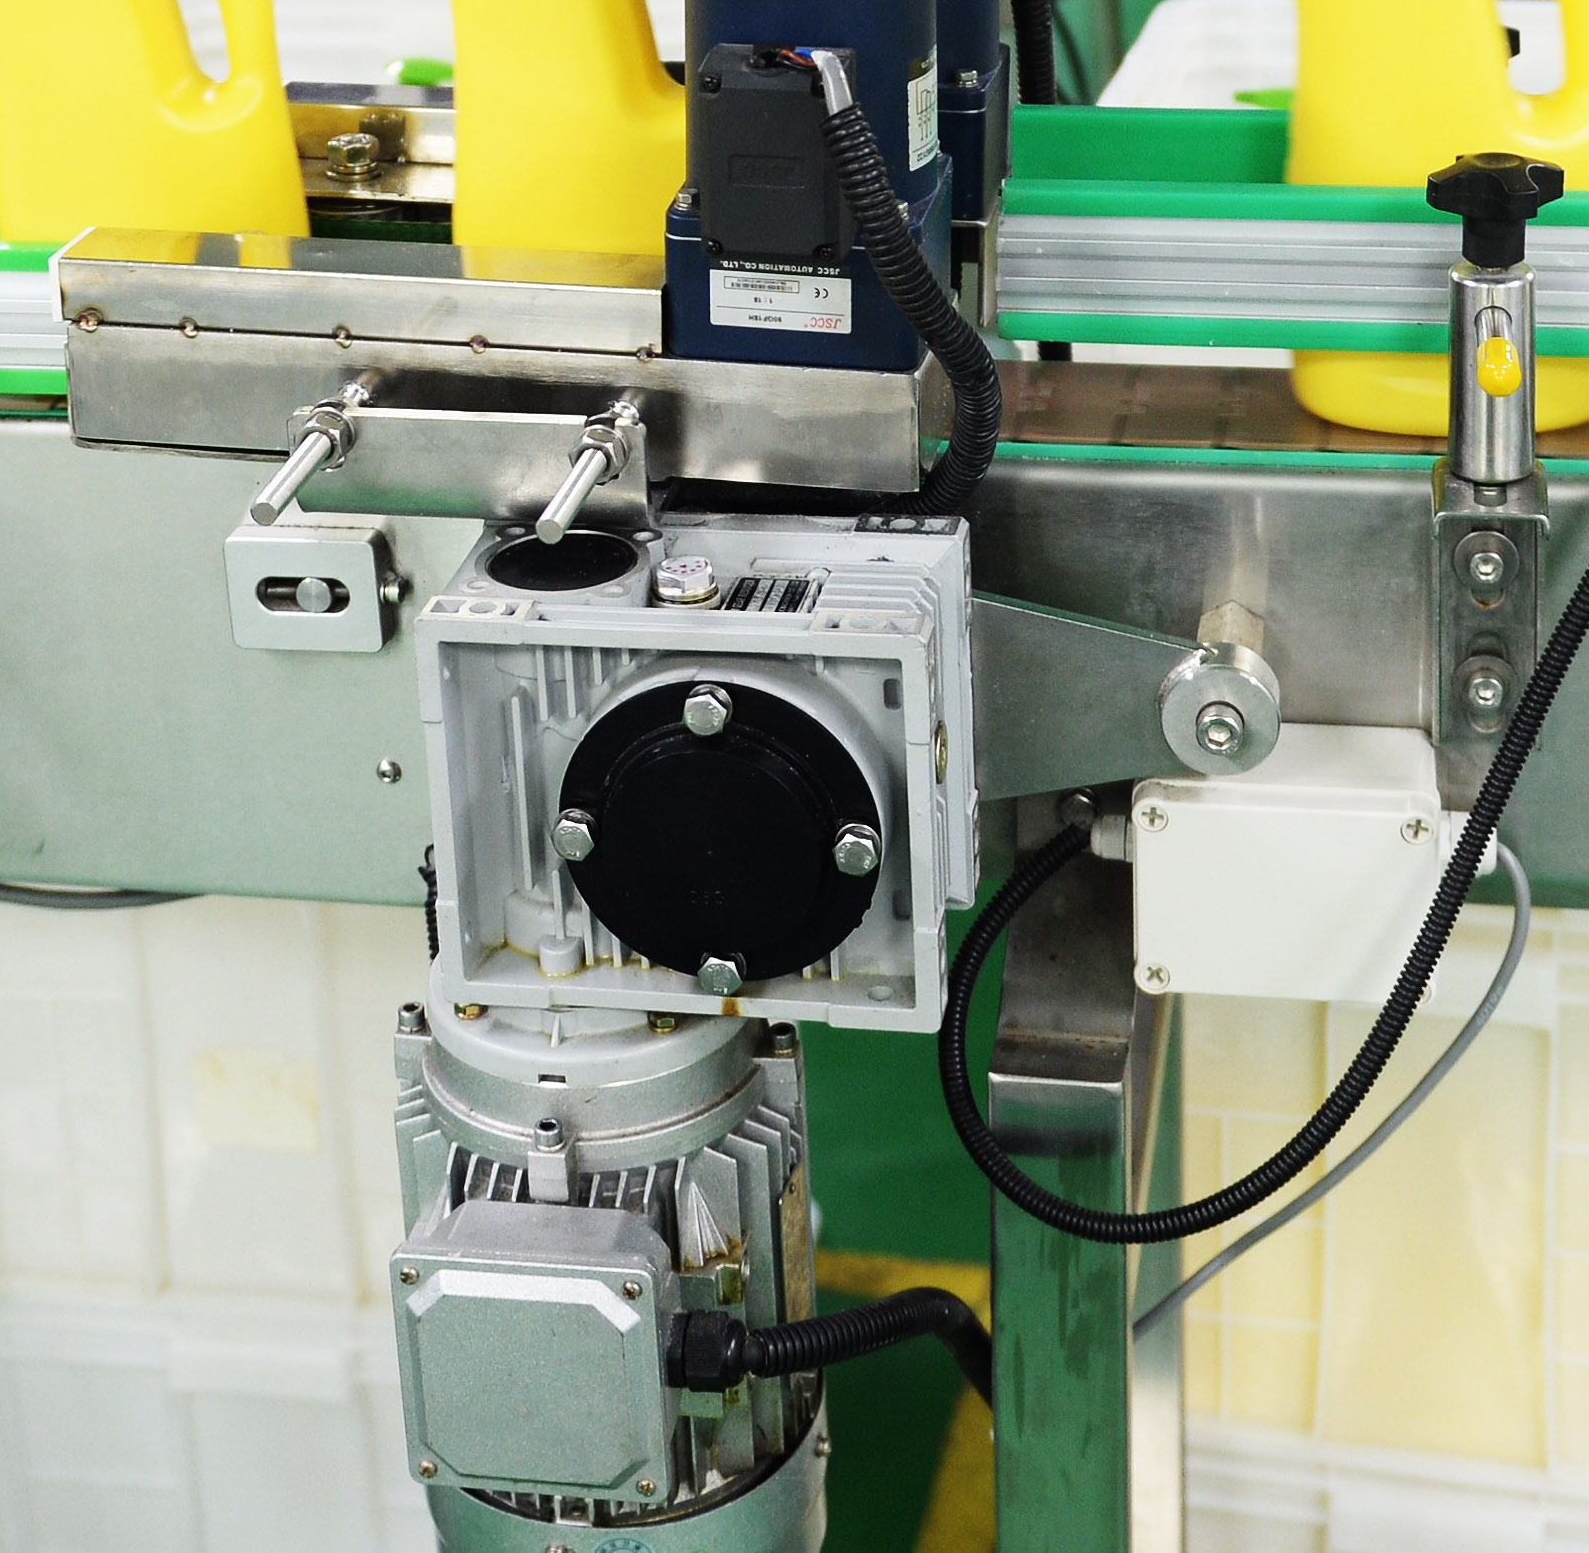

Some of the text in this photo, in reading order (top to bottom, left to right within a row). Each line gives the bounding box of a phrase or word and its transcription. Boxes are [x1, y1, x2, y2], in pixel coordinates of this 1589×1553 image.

[758, 263, 813, 273] AUTOMATION
[817, 267, 841, 276] JSCC
[810, 317, 842, 330] JSCC
